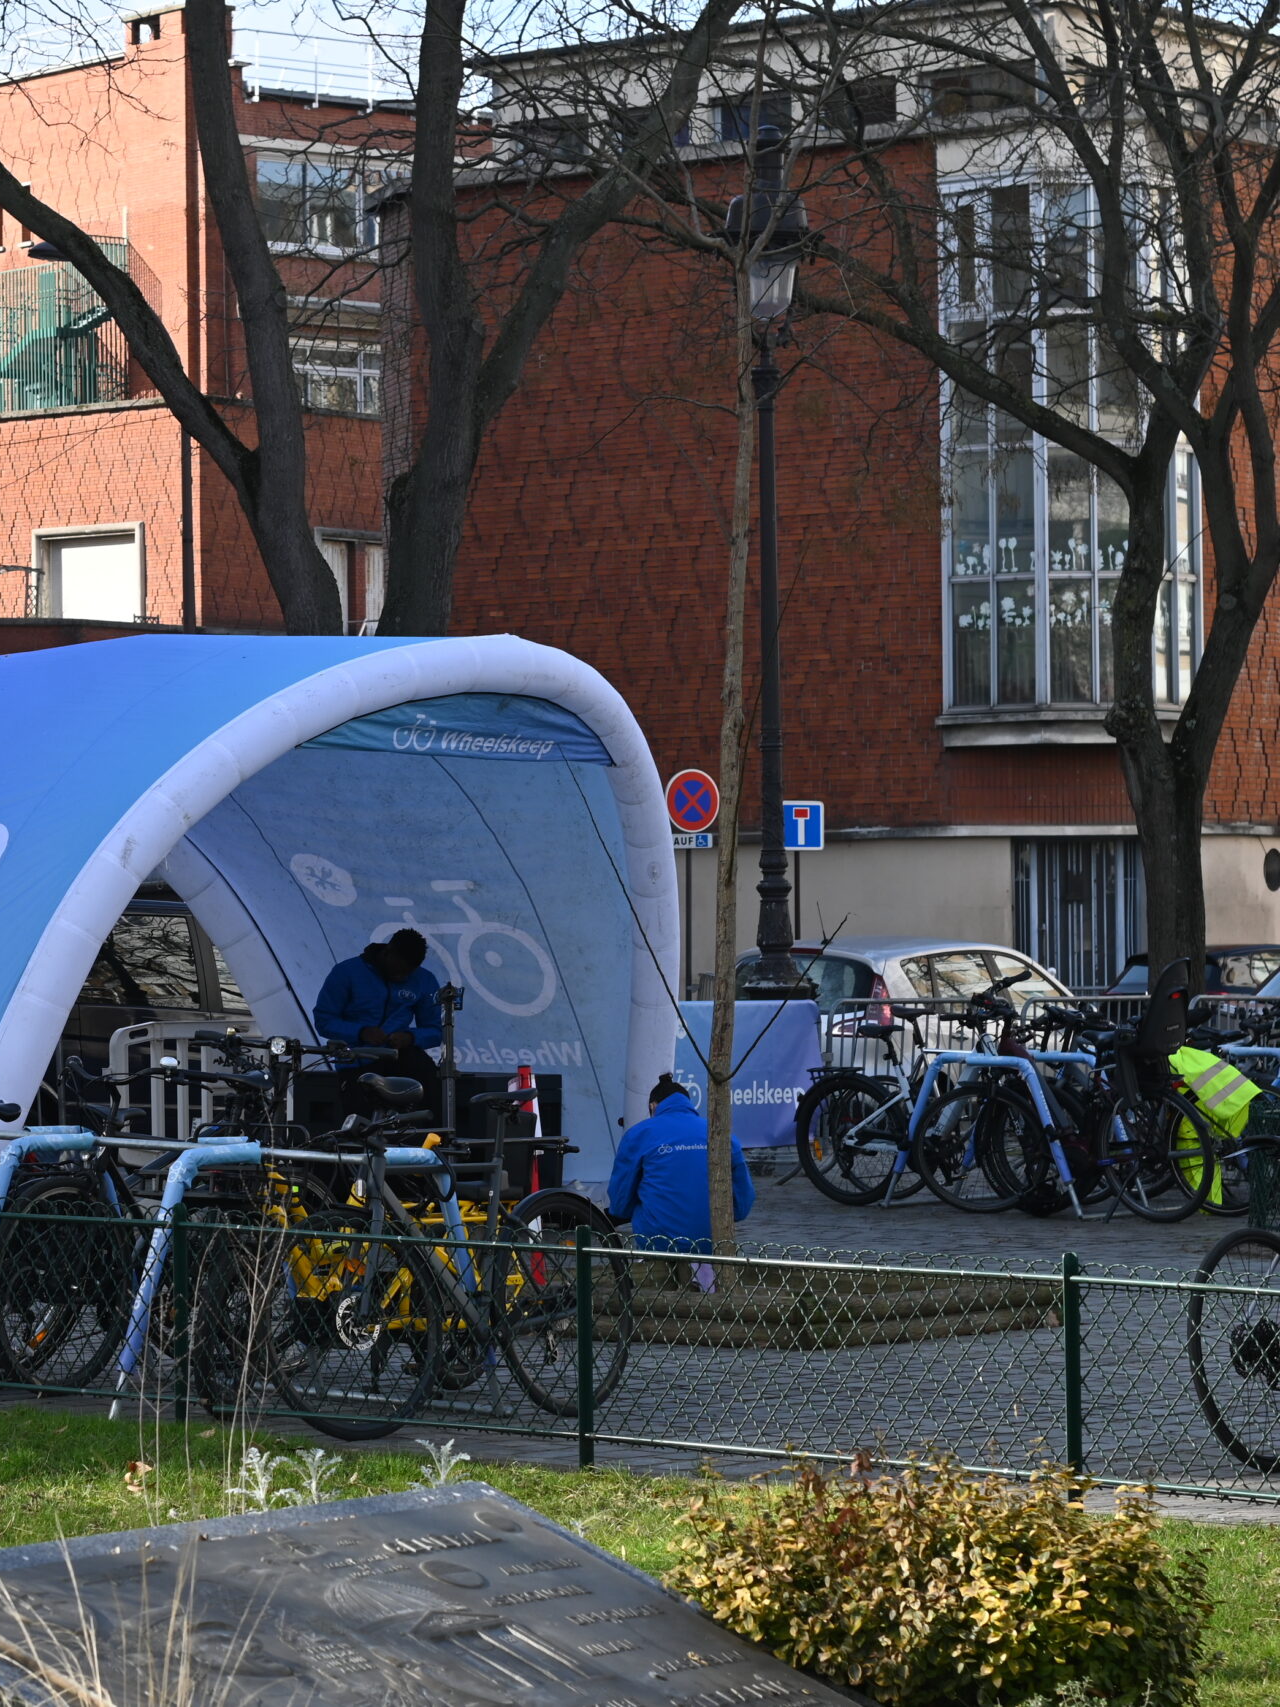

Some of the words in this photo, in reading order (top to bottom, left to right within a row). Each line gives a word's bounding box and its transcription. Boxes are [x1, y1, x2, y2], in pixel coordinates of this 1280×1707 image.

[440, 730, 555, 760] Wheelskeep
[673, 836, 694, 846] AUF
[729, 1079, 806, 1110] eelskeep
